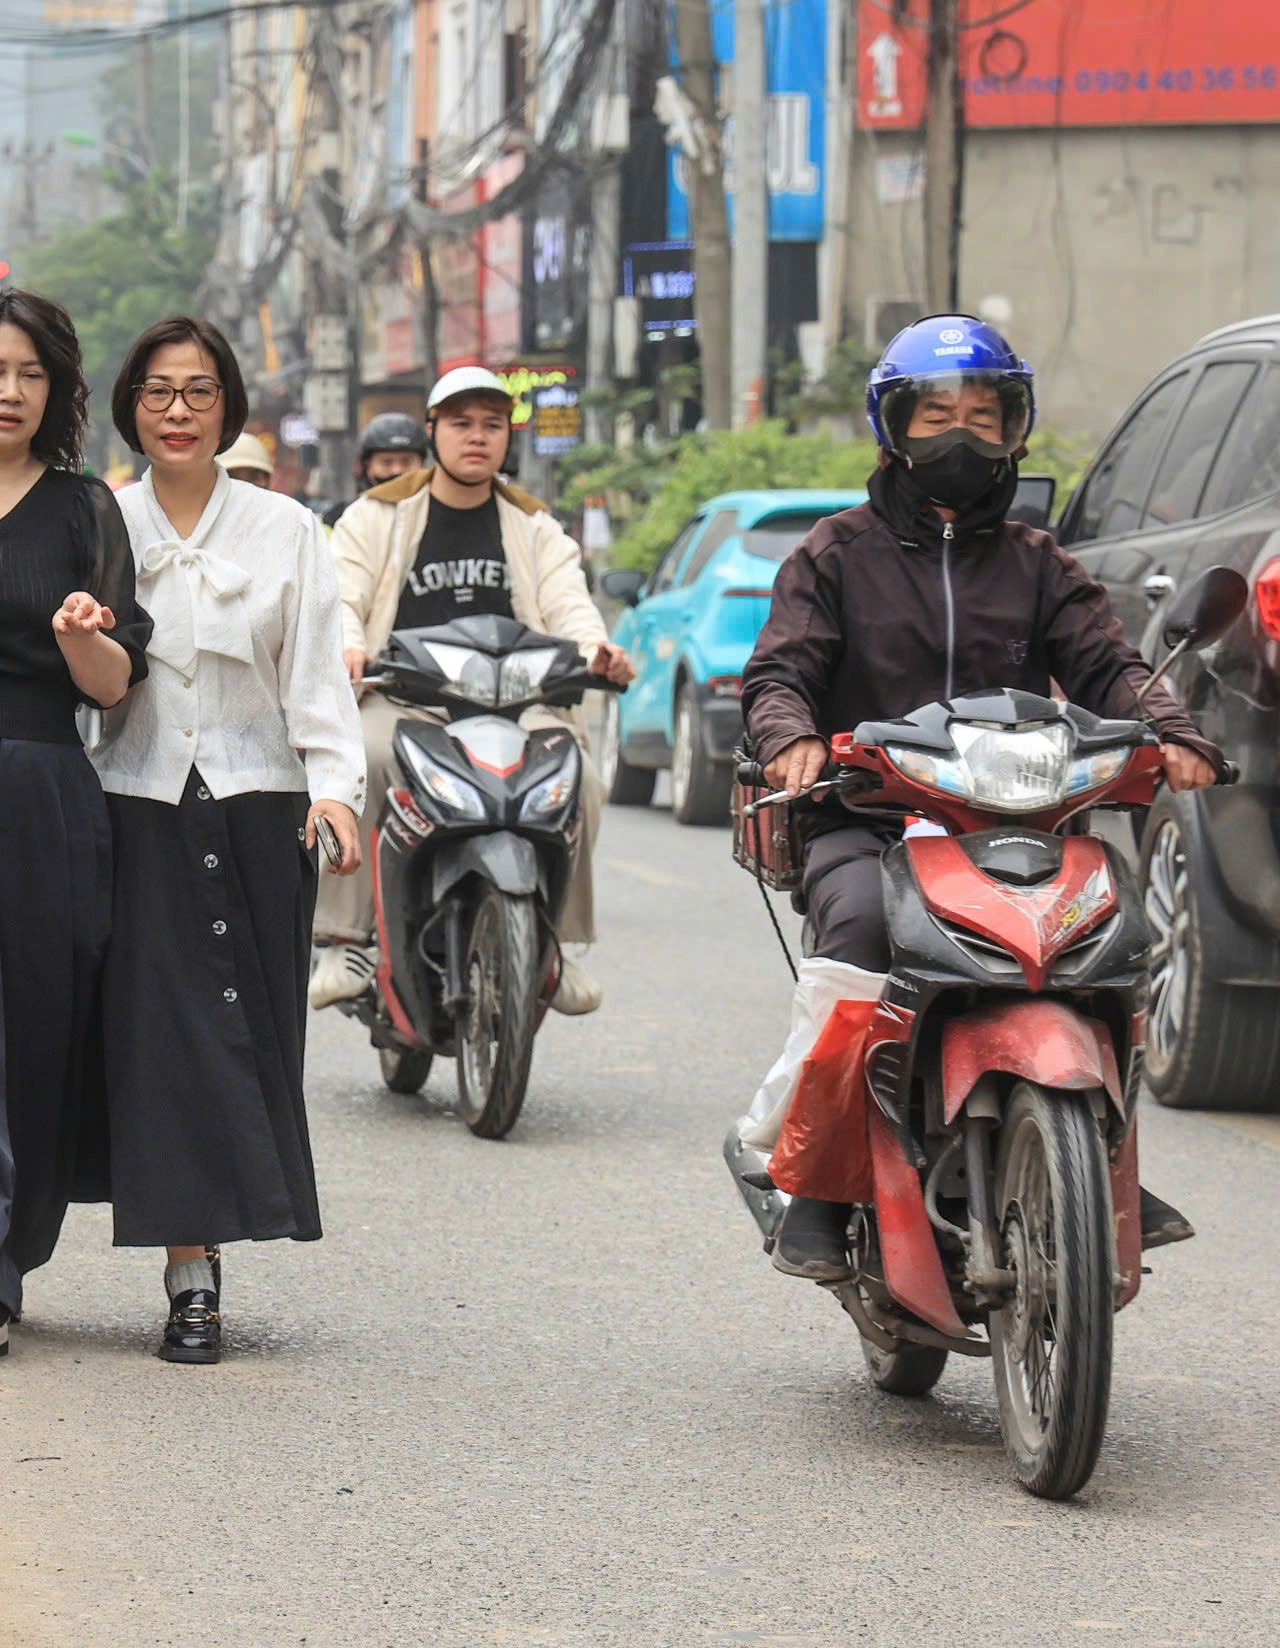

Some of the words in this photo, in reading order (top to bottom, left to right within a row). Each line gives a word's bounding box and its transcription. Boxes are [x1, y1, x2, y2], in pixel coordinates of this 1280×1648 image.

[962, 75, 1061, 96] otline
[1076, 68, 1149, 94] 0904
[1156, 68, 1194, 92] 40
[1201, 66, 1236, 91] 36
[1242, 65, 1277, 90] 56
[933, 345, 975, 357] YAMAHA
[987, 836, 1049, 849] HONDA
